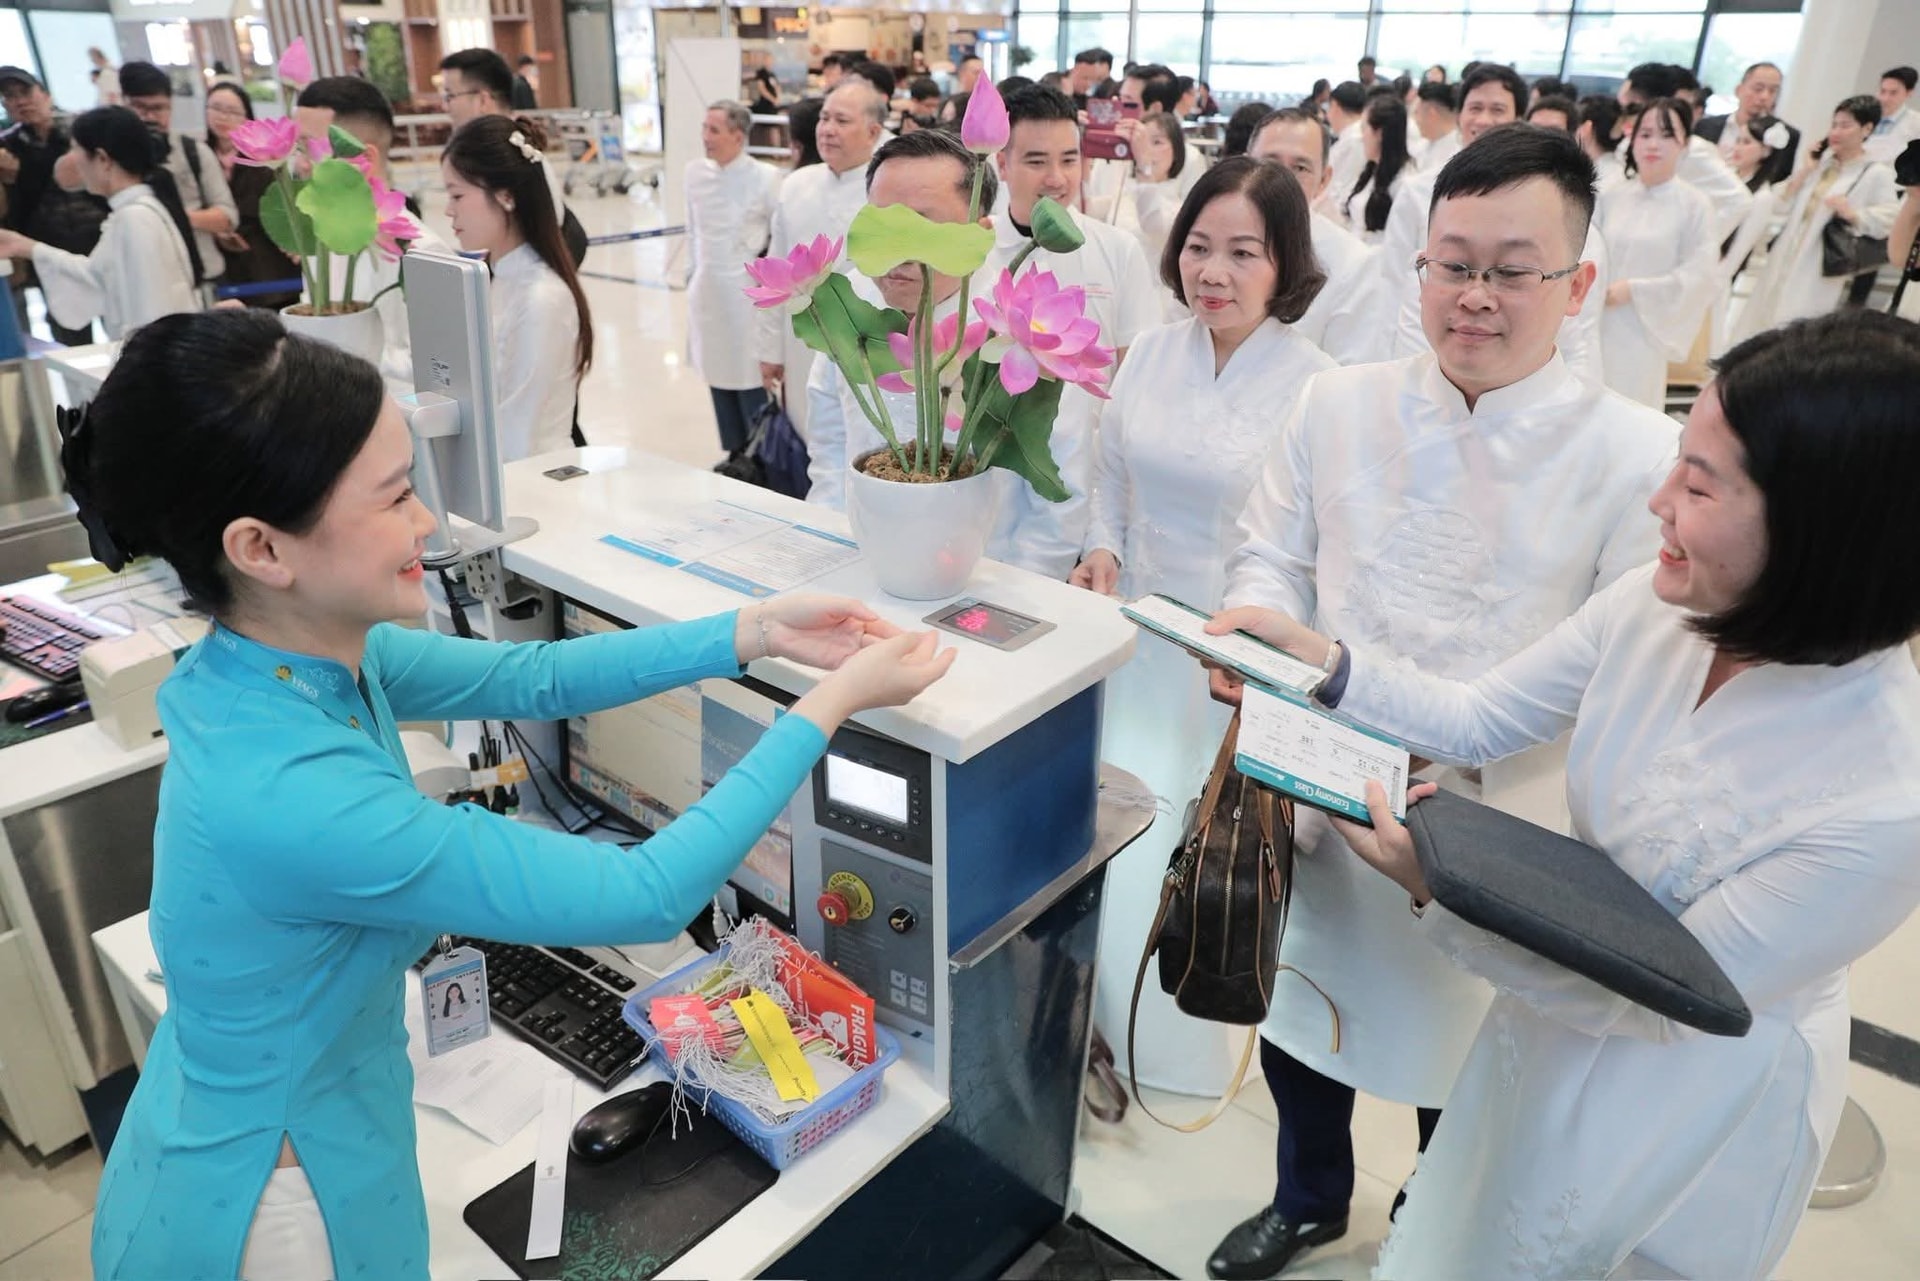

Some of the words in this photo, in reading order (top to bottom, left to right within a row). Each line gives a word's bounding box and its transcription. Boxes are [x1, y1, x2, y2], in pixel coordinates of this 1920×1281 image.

[292, 675, 319, 698] VIAGS
[1294, 781, 1314, 797] Class
[1315, 787, 1350, 811] Economy
[850, 1003, 868, 1060] FRAGIL
